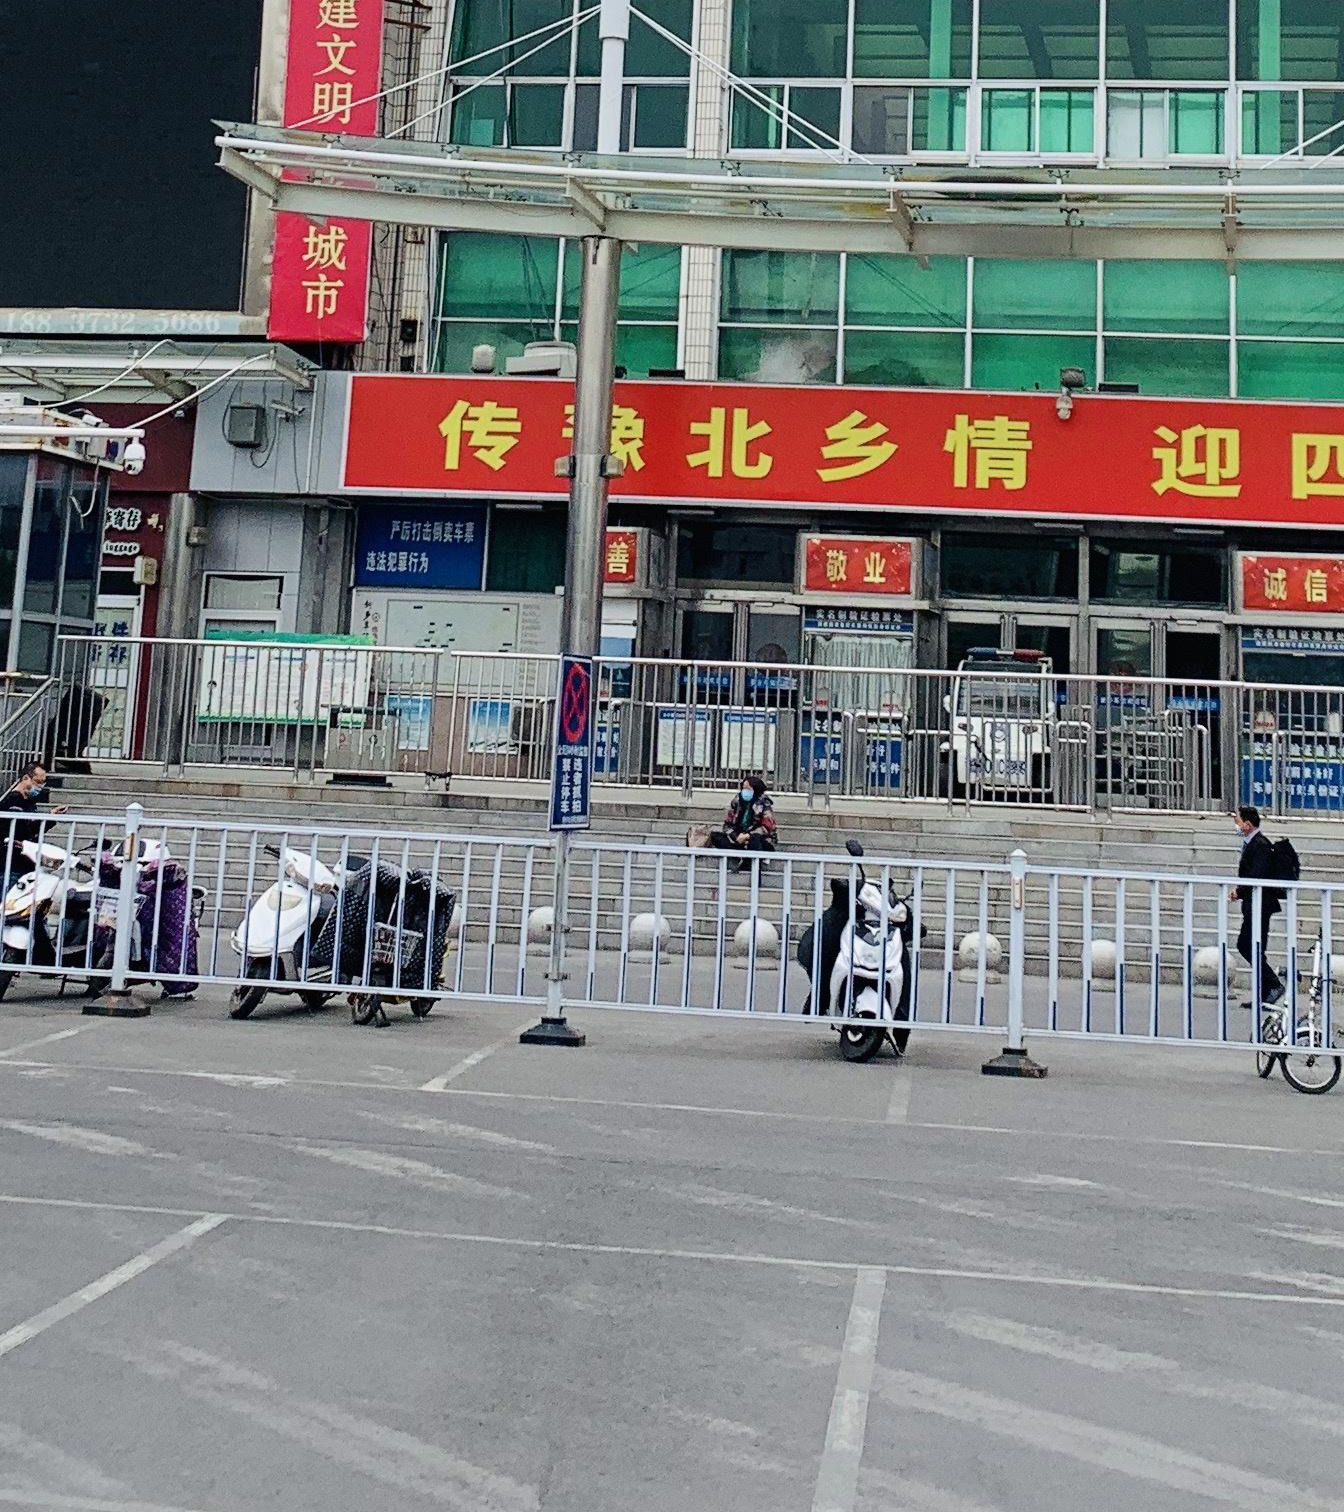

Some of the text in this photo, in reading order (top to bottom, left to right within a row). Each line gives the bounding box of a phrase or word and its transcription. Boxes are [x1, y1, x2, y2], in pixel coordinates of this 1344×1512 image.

[439, 399, 1033, 490] 传豫北乡情
[390, 520, 475, 543] 严厉打击倒卖车票
[365, 551, 429, 573] 违法犯罪行为
[826, 549, 887, 583] 敬业
[1263, 568, 1329, 604] 诚信
